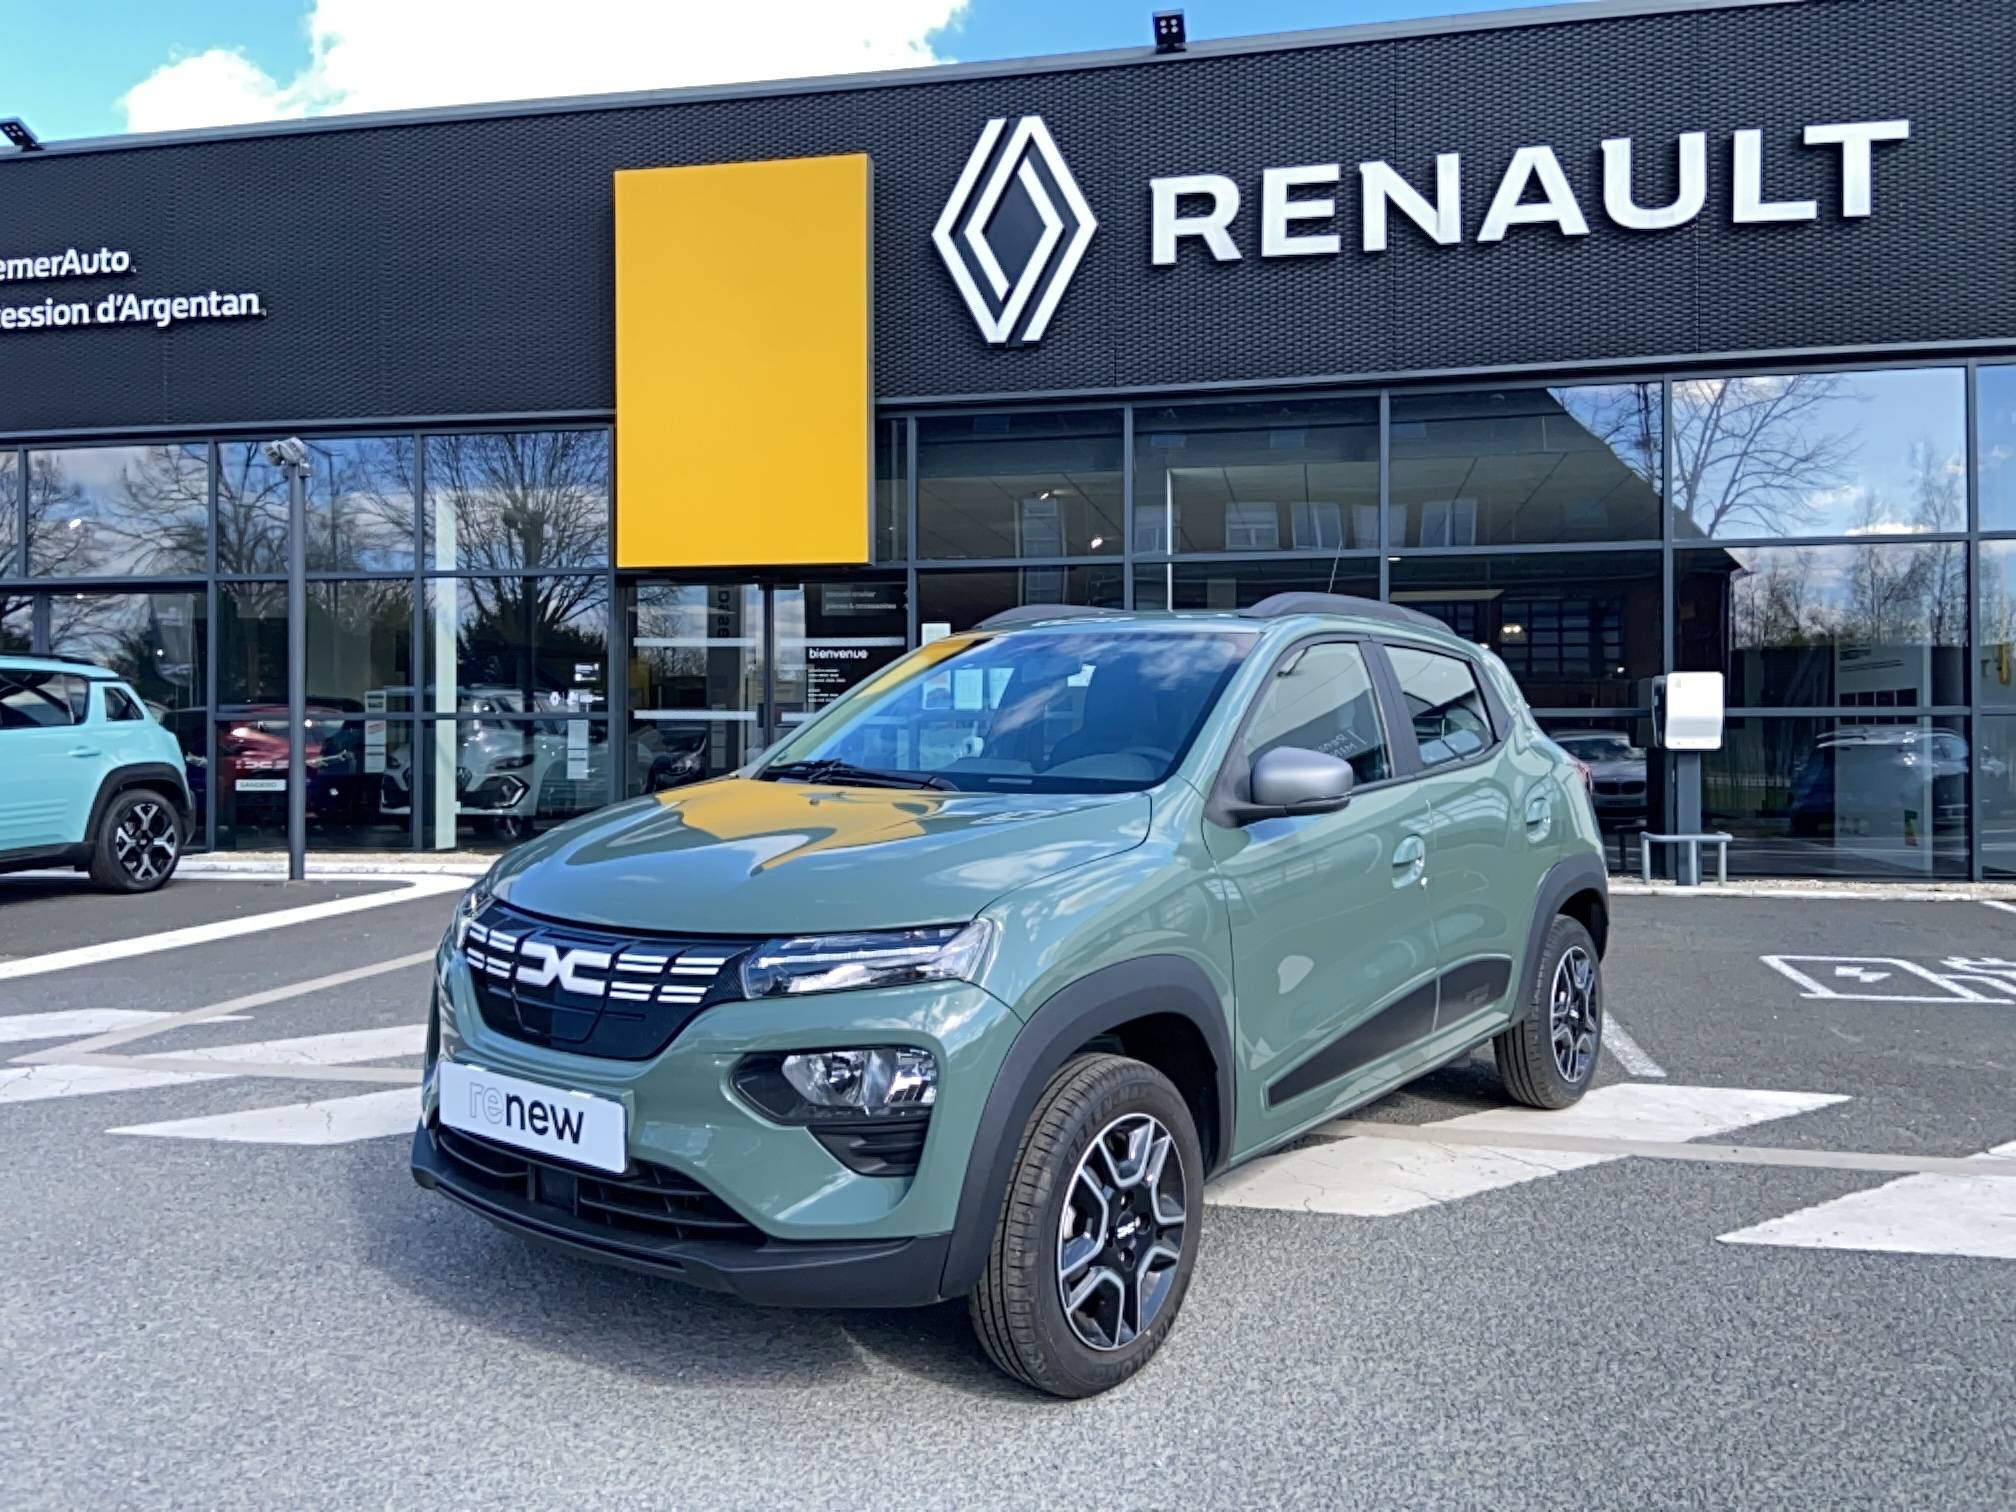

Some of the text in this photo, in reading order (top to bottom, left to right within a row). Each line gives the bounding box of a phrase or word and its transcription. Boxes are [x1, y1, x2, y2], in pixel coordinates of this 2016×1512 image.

[1150, 119, 1911, 266] RENAULT
[0, 297, 90, 330] ession
[808, 647, 868, 659] bienvenue
[469, 1081, 585, 1144] renew
